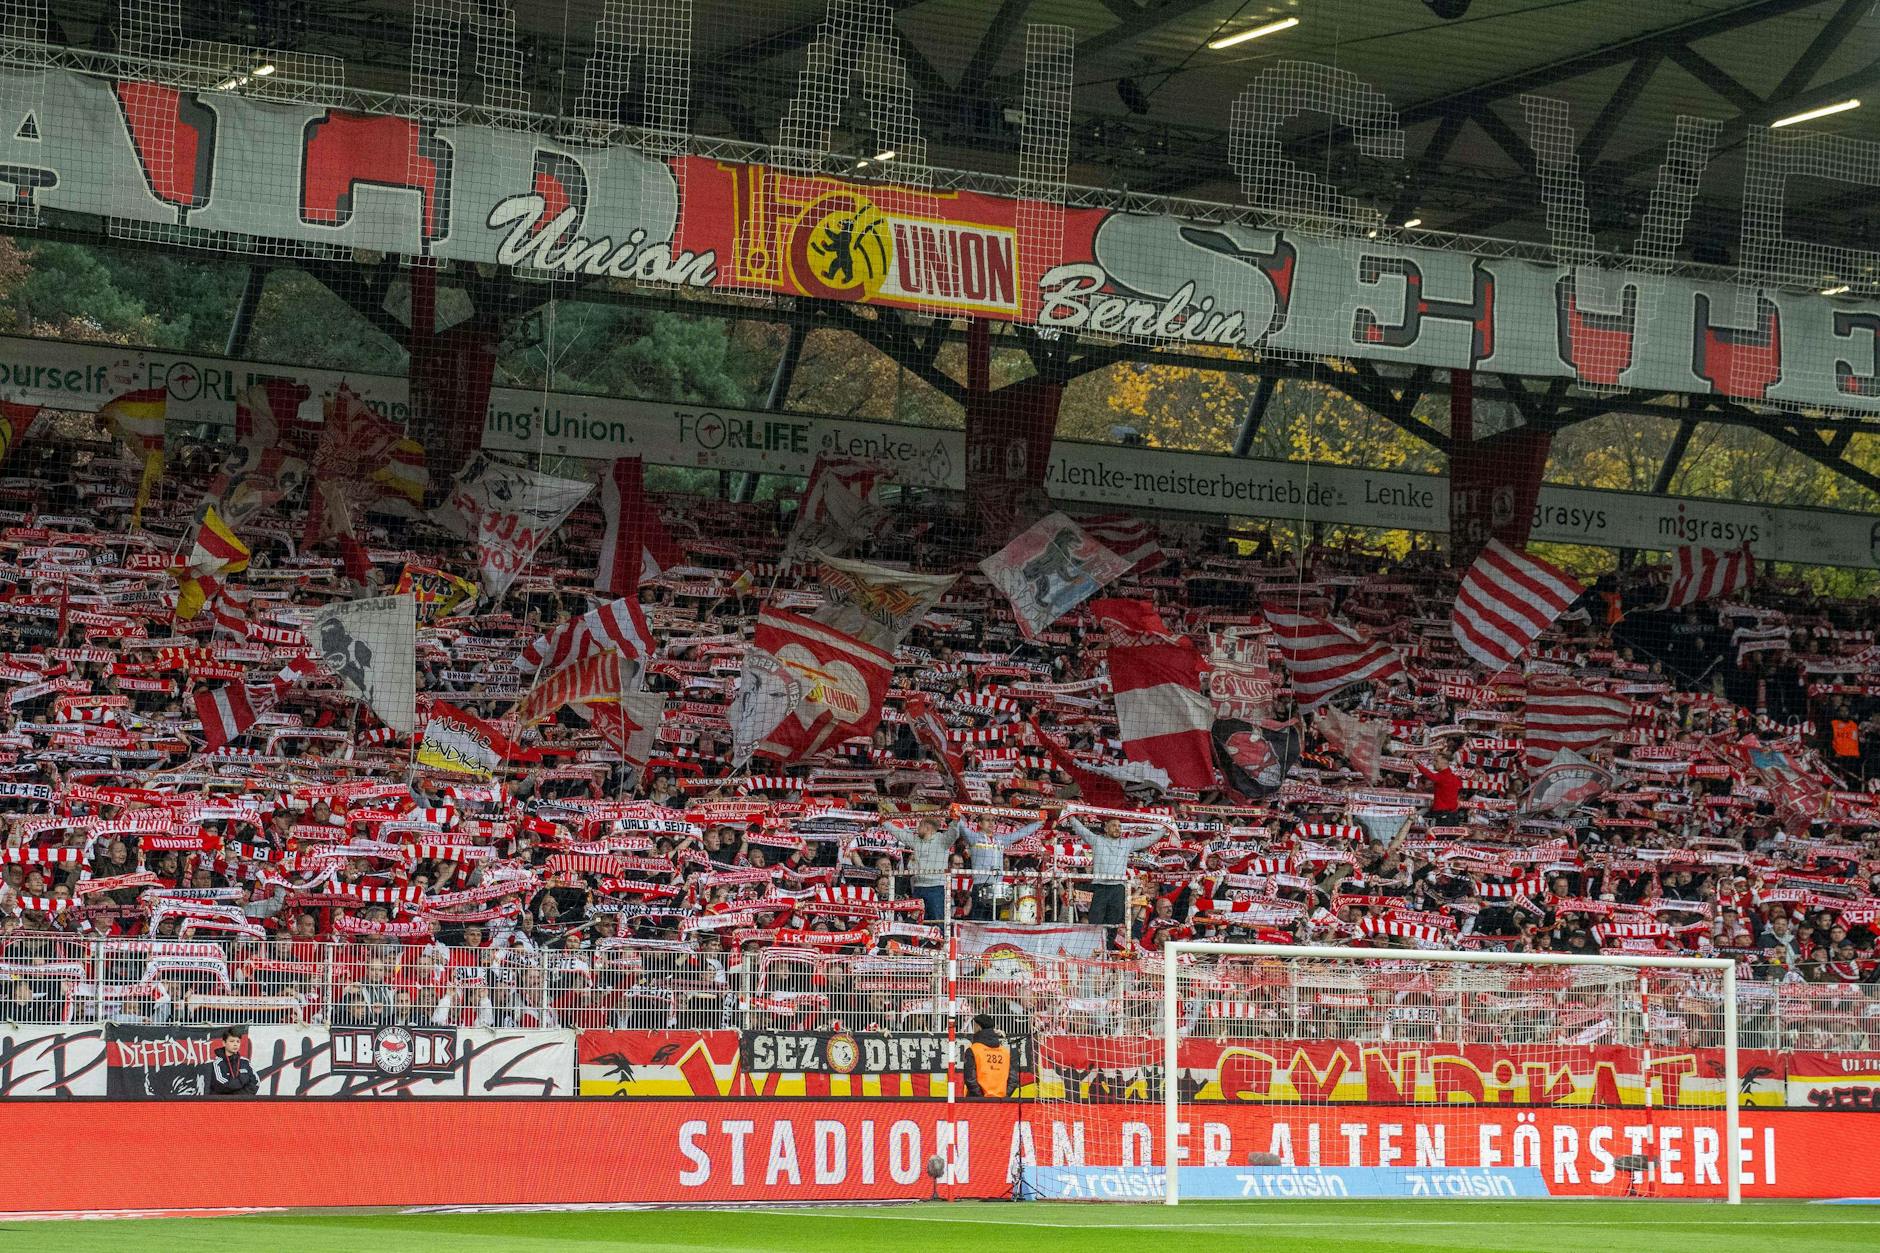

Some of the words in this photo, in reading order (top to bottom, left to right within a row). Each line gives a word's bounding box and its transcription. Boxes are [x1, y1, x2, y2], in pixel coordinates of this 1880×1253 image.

[487, 195, 716, 287] Union
[1038, 262, 1248, 346] Berlin
[893, 222, 1014, 305] UNION
[543, 408, 634, 444] Union.
[677, 411, 811, 453] FORLIFE
[832, 429, 912, 461] Lenke
[1364, 480, 1434, 510] Lenke
[1657, 502, 1761, 544] migrasys
[121, 592, 160, 602] BERLIN
[822, 684, 860, 714] UNION
[1695, 765, 1730, 774] UNIONER
[550, 799, 579, 811] UNION
[130, 807, 173, 821] UNION
[621, 818, 649, 830] WALD
[664, 821, 693, 834] SEITE
[151, 838, 204, 849] UNIONER
[855, 835, 888, 849] WALD
[603, 877, 616, 890] FC
[617, 878, 656, 891] UNION
[172, 889, 219, 899] BERLIN
[815, 903, 850, 913] UNION
[335, 918, 379, 933] UNION
[384, 920, 430, 935] BERLIN
[1395, 910, 1424, 923] EISERN
[1425, 915, 1456, 929] UNION
[792, 933, 803, 943] FC
[804, 933, 833, 944] UNION
[833, 931, 863, 944] BERLIN
[1602, 922, 1675, 939] UNION
[752, 1035, 828, 1070] SEZ.
[986, 1053, 1004, 1065] 282
[678, 1119, 971, 1187] STADION
[1006, 1120, 1086, 1185] AN
[1478, 1111, 1777, 1185] FÖRSTEREI
[1261, 1167, 1349, 1198] raisin
[1429, 1167, 1515, 1198] raisin
